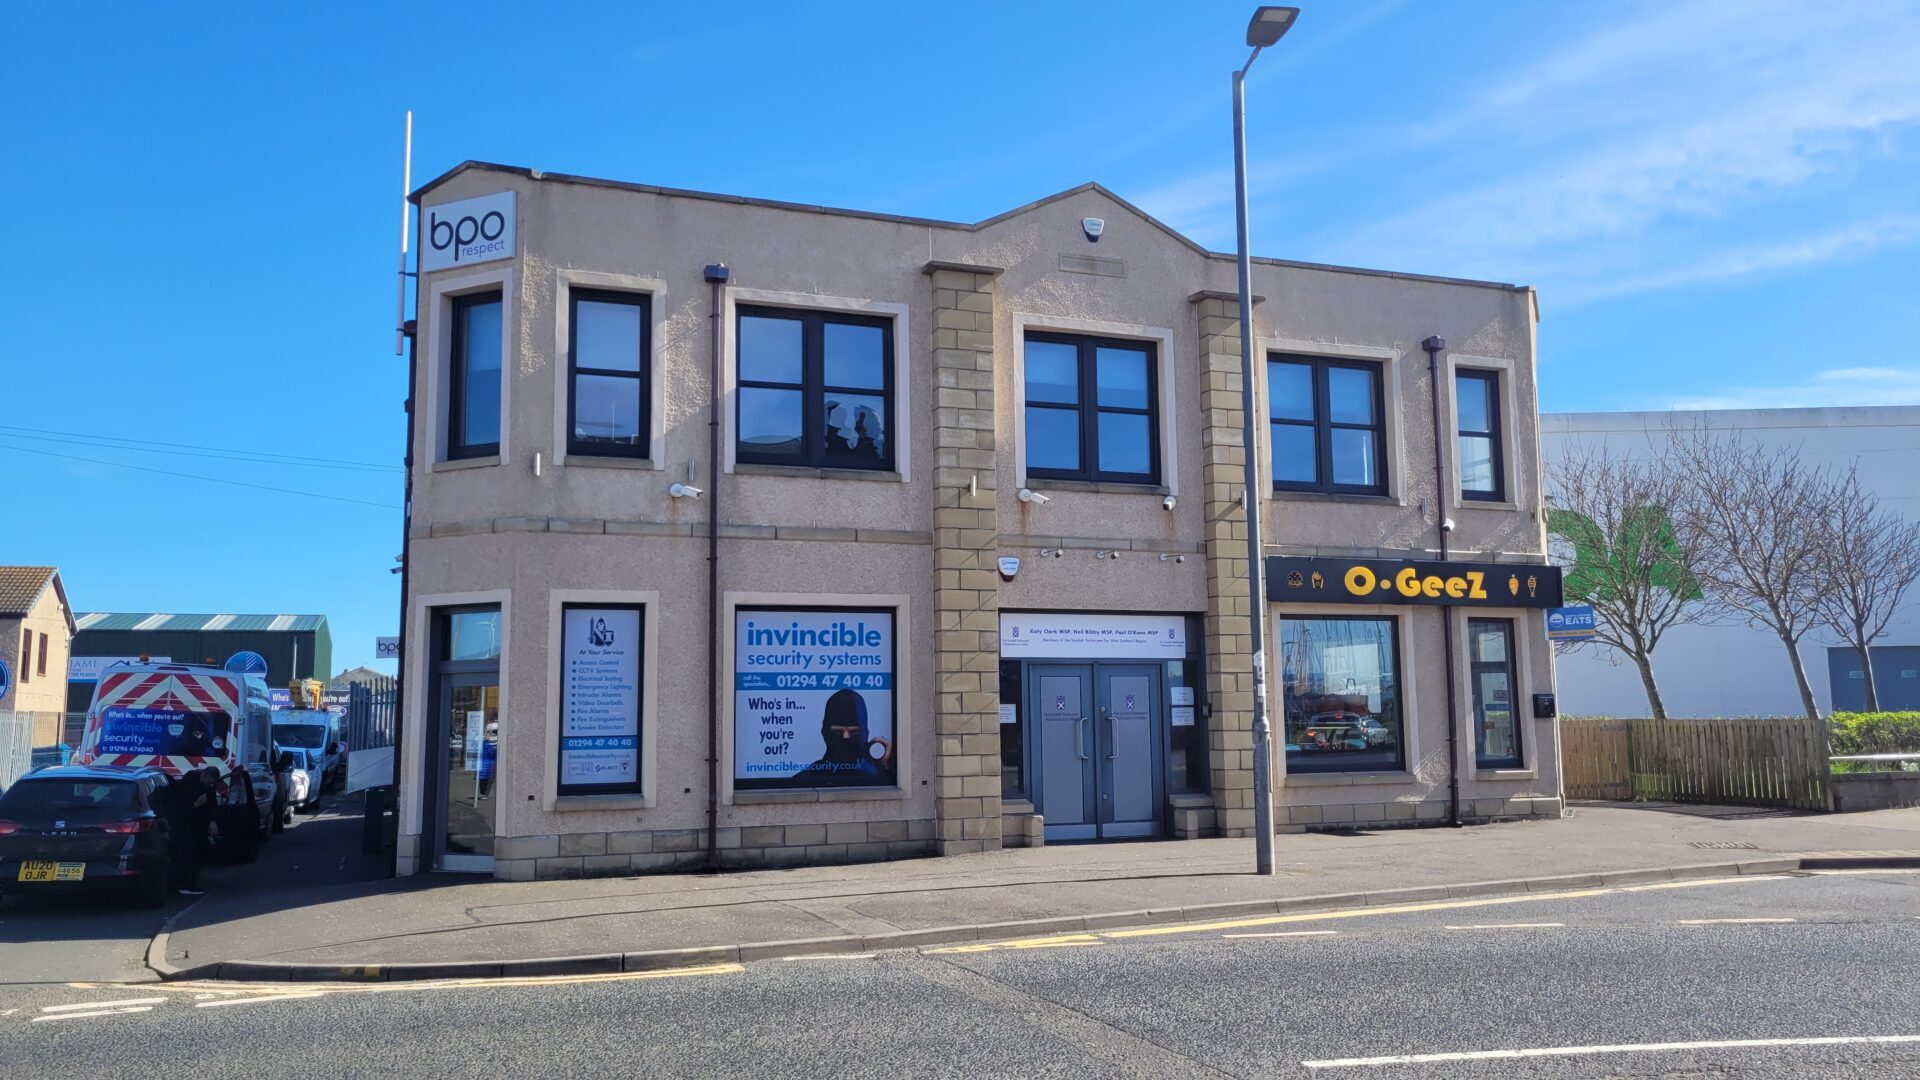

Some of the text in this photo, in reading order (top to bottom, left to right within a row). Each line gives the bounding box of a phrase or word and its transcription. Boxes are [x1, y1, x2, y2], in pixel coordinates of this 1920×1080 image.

[431, 211, 505, 261] bpo
[462, 240, 505, 258] respect
[1565, 617, 1591, 625] EATS
[747, 621, 882, 647] invincible
[747, 650, 882, 670] security systems
[776, 675, 883, 687] 01294 47 40 40
[748, 697, 806, 710] Who's in...
[761, 712, 793, 725] when
[760, 728, 794, 743] you're
[568, 739, 593, 747] 01294
[595, 739, 605, 747] 47
[764, 742, 789, 755] out?
[746, 759, 863, 774] invinciblesecurity.co.uk
[24, 861, 53, 871] AU20
